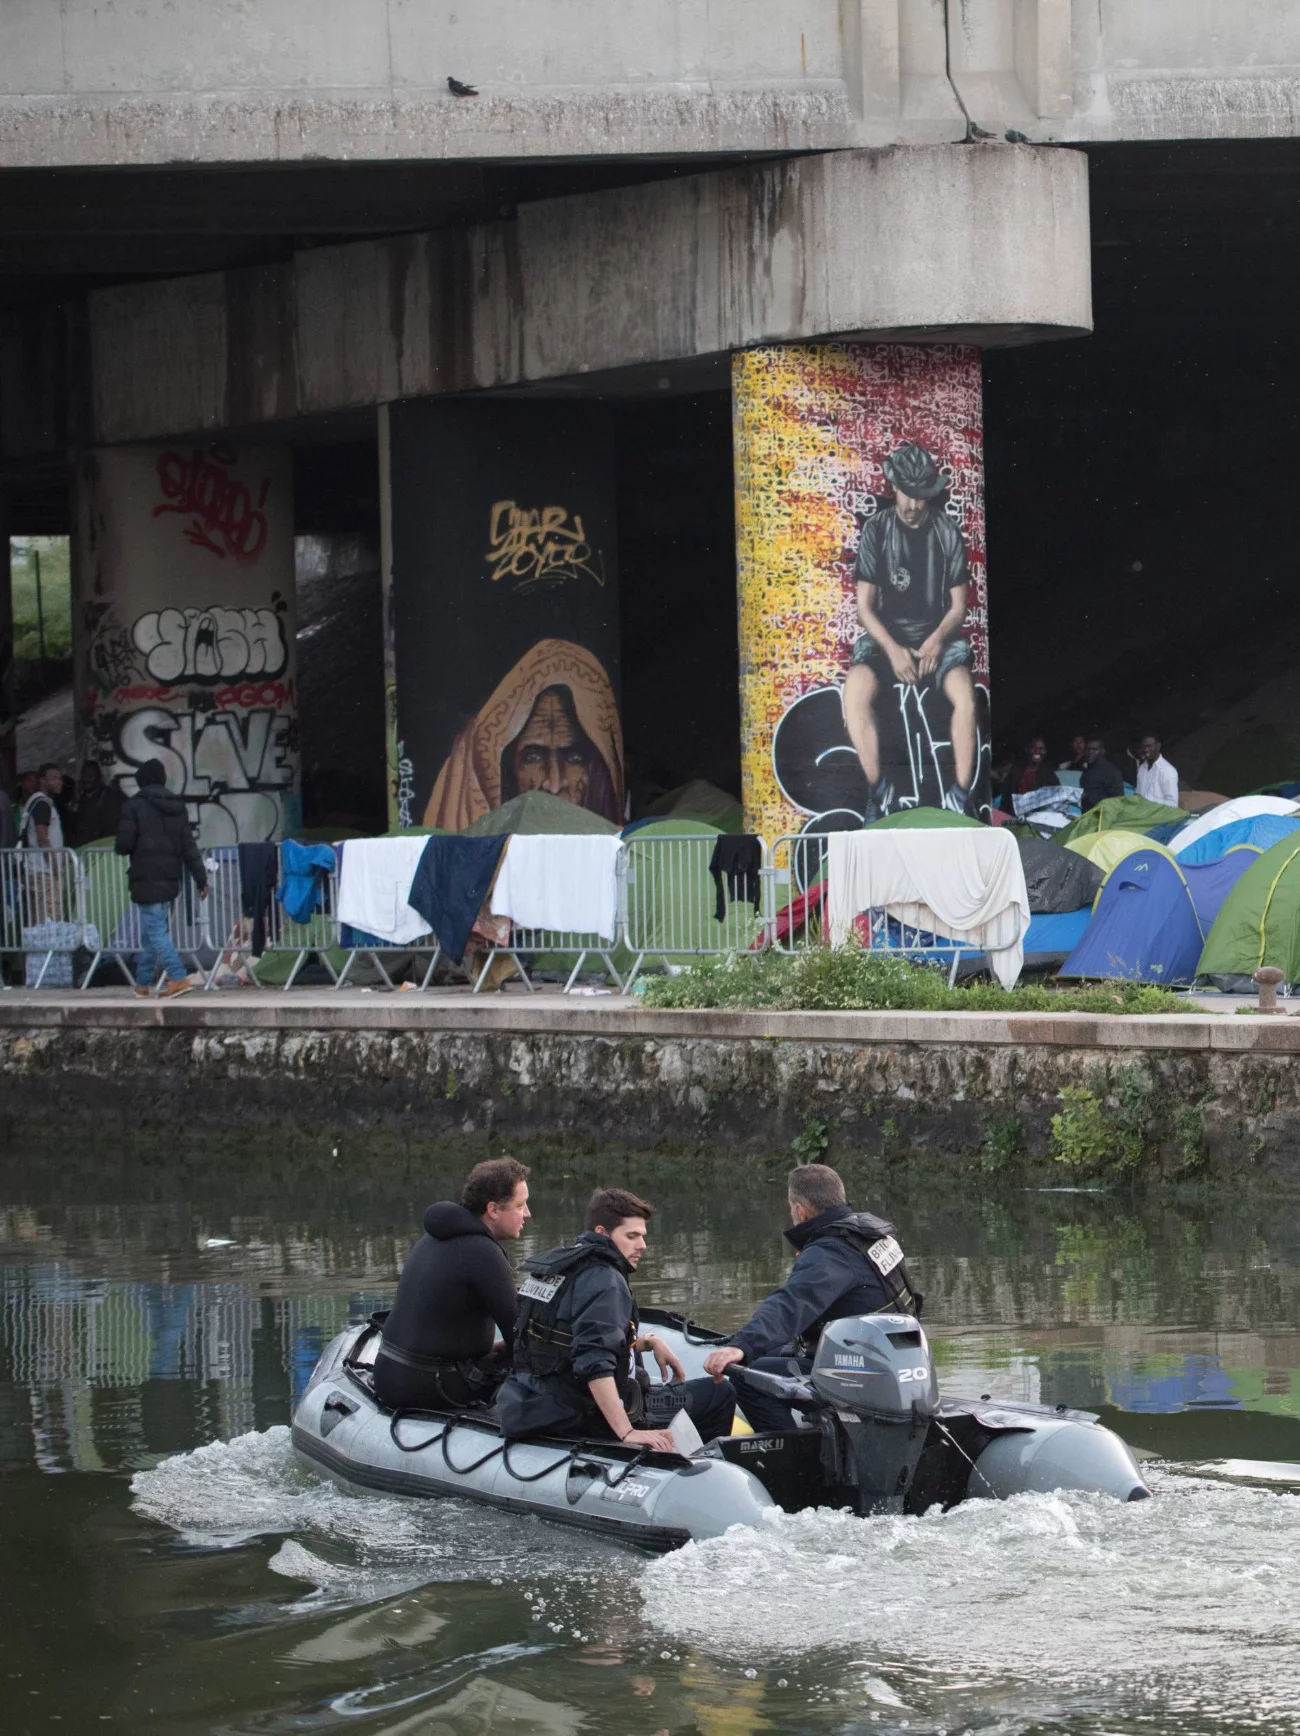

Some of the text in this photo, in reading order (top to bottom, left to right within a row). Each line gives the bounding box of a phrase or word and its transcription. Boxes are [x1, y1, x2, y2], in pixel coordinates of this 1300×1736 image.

[520, 1282, 555, 1300] LUVIALE
[834, 1353, 865, 1368] YAMAHA
[898, 1366, 928, 1383] 20
[740, 1439, 773, 1452] MARK
